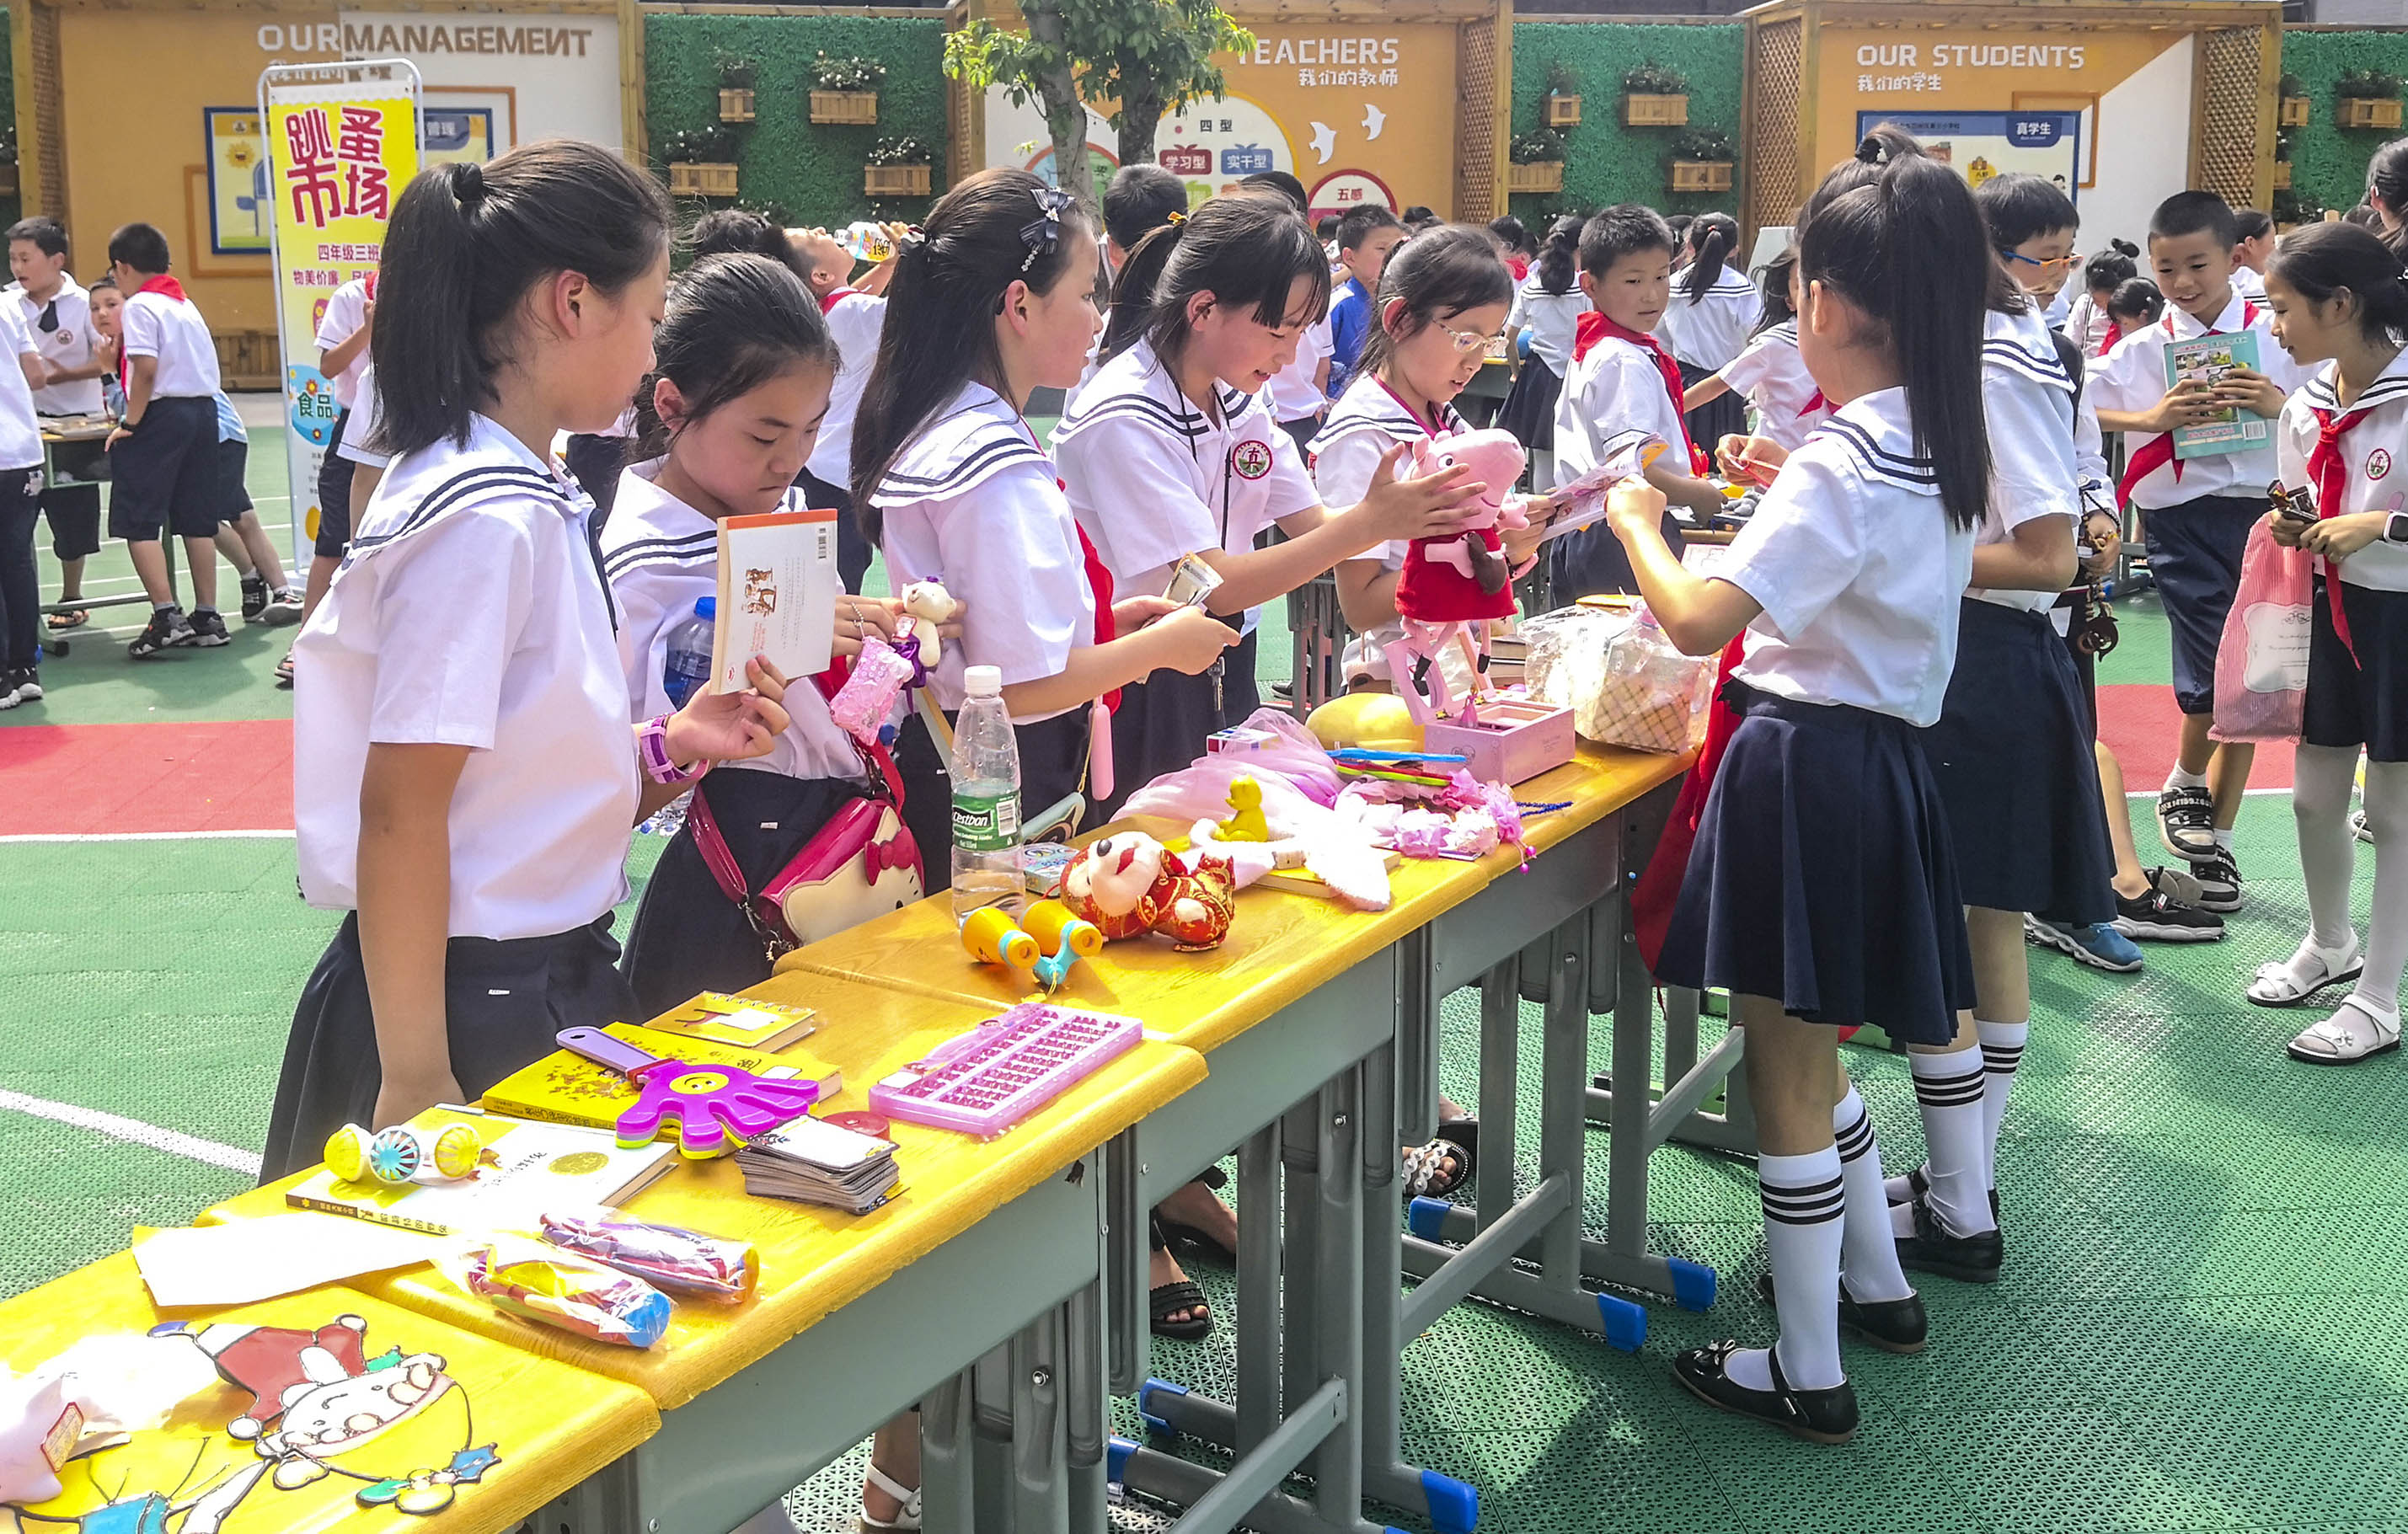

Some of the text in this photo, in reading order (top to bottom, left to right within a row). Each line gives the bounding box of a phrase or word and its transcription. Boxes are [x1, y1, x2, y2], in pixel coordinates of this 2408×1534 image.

[257, 24, 592, 56] OUR MANAGEMENT
[1856, 45, 2084, 69] OUR STUDENTS
[1299, 67, 1399, 87] 我们的教师
[1857, 71, 1942, 92] 我们的学生
[285, 105, 384, 166] 跳蚤
[1200, 119, 1233, 132] 四型
[2015, 121, 2051, 136] 真学生
[1165, 155, 1207, 169] 学习型
[1227, 154, 1267, 168] 实干型
[286, 157, 388, 228] 市场
[318, 244, 380, 261] 四年级三班
[297, 392, 333, 419] 食品
